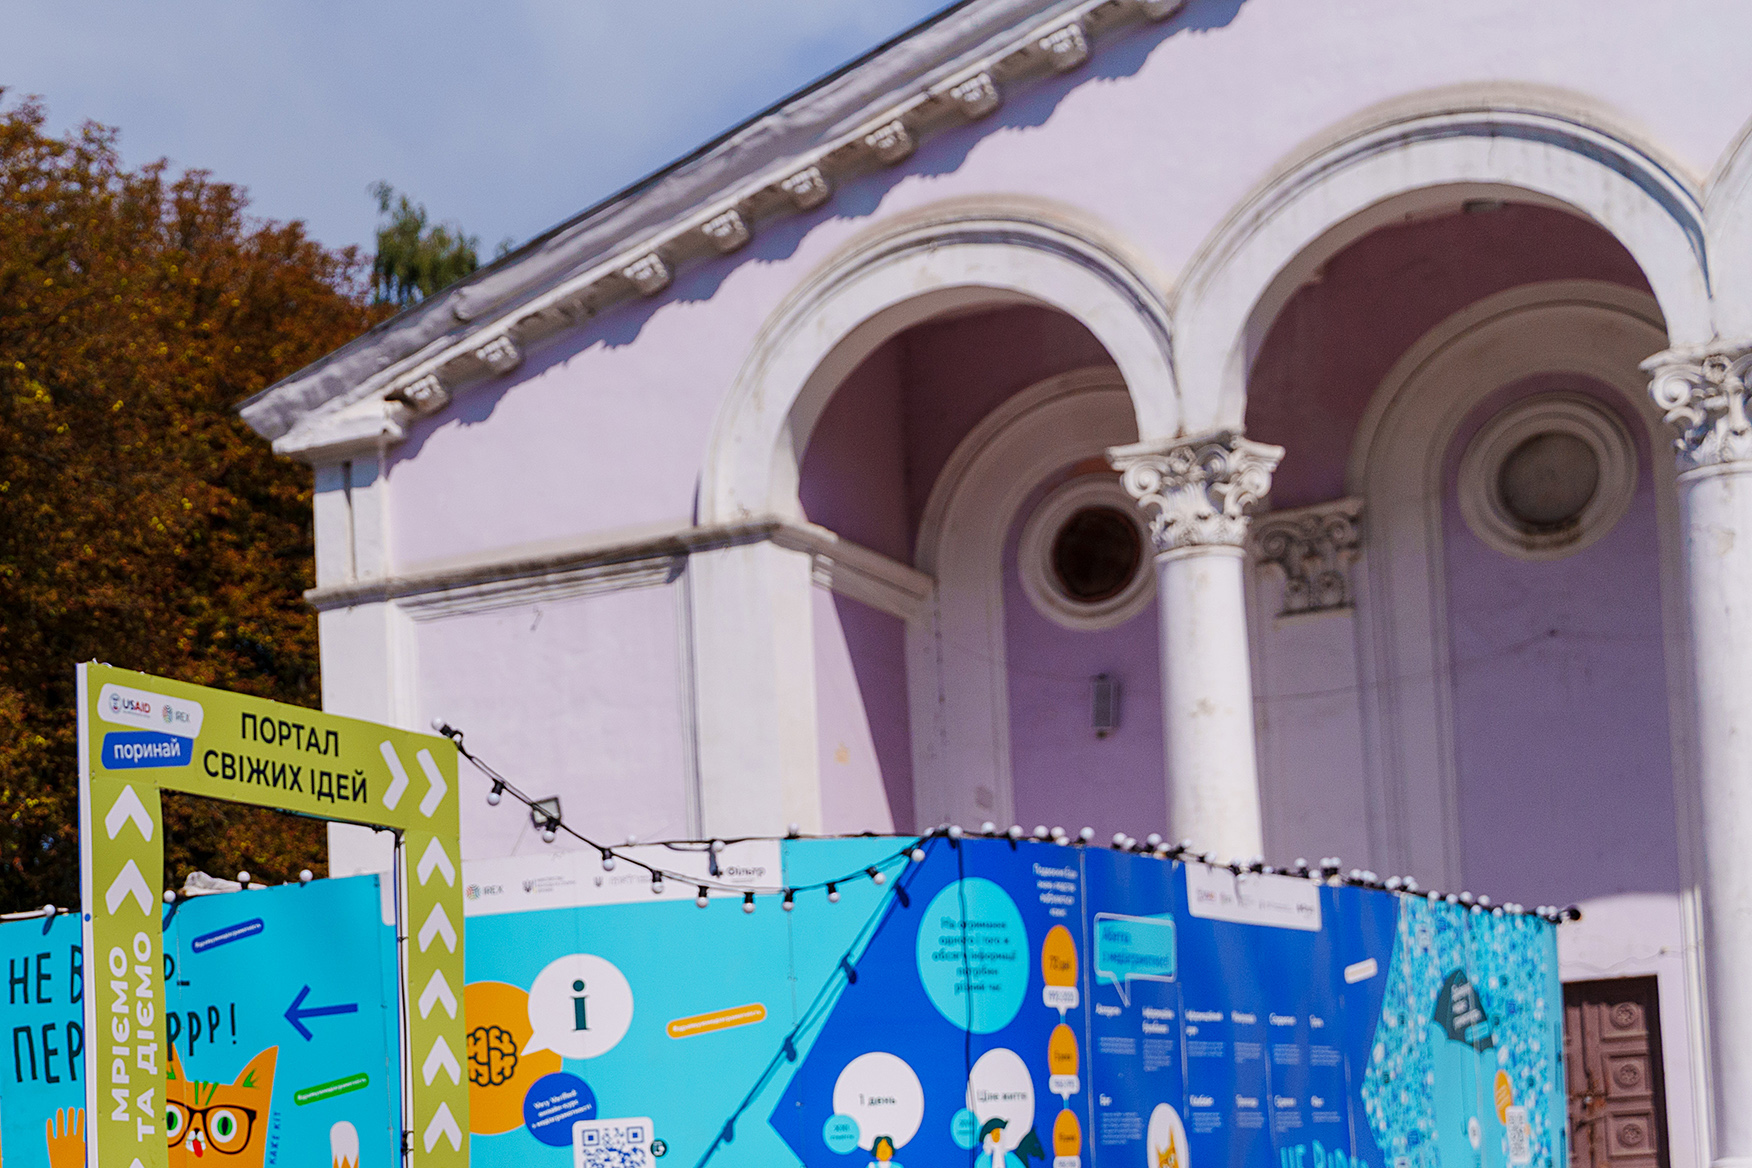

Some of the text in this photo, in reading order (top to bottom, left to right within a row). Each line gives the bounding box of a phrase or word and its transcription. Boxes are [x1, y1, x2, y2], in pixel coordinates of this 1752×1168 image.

[122, 698, 151, 714] USAID
[113, 737, 181, 763] поринай
[241, 711, 339, 758] ПОРТАЛ
[203, 749, 368, 804] СВІЖИХ ІДЕЙ
[9, 952, 52, 1004] НЕ
[108, 946, 130, 1122] МРІЄМО
[133, 931, 158, 1142] ТА ДІЄМО
